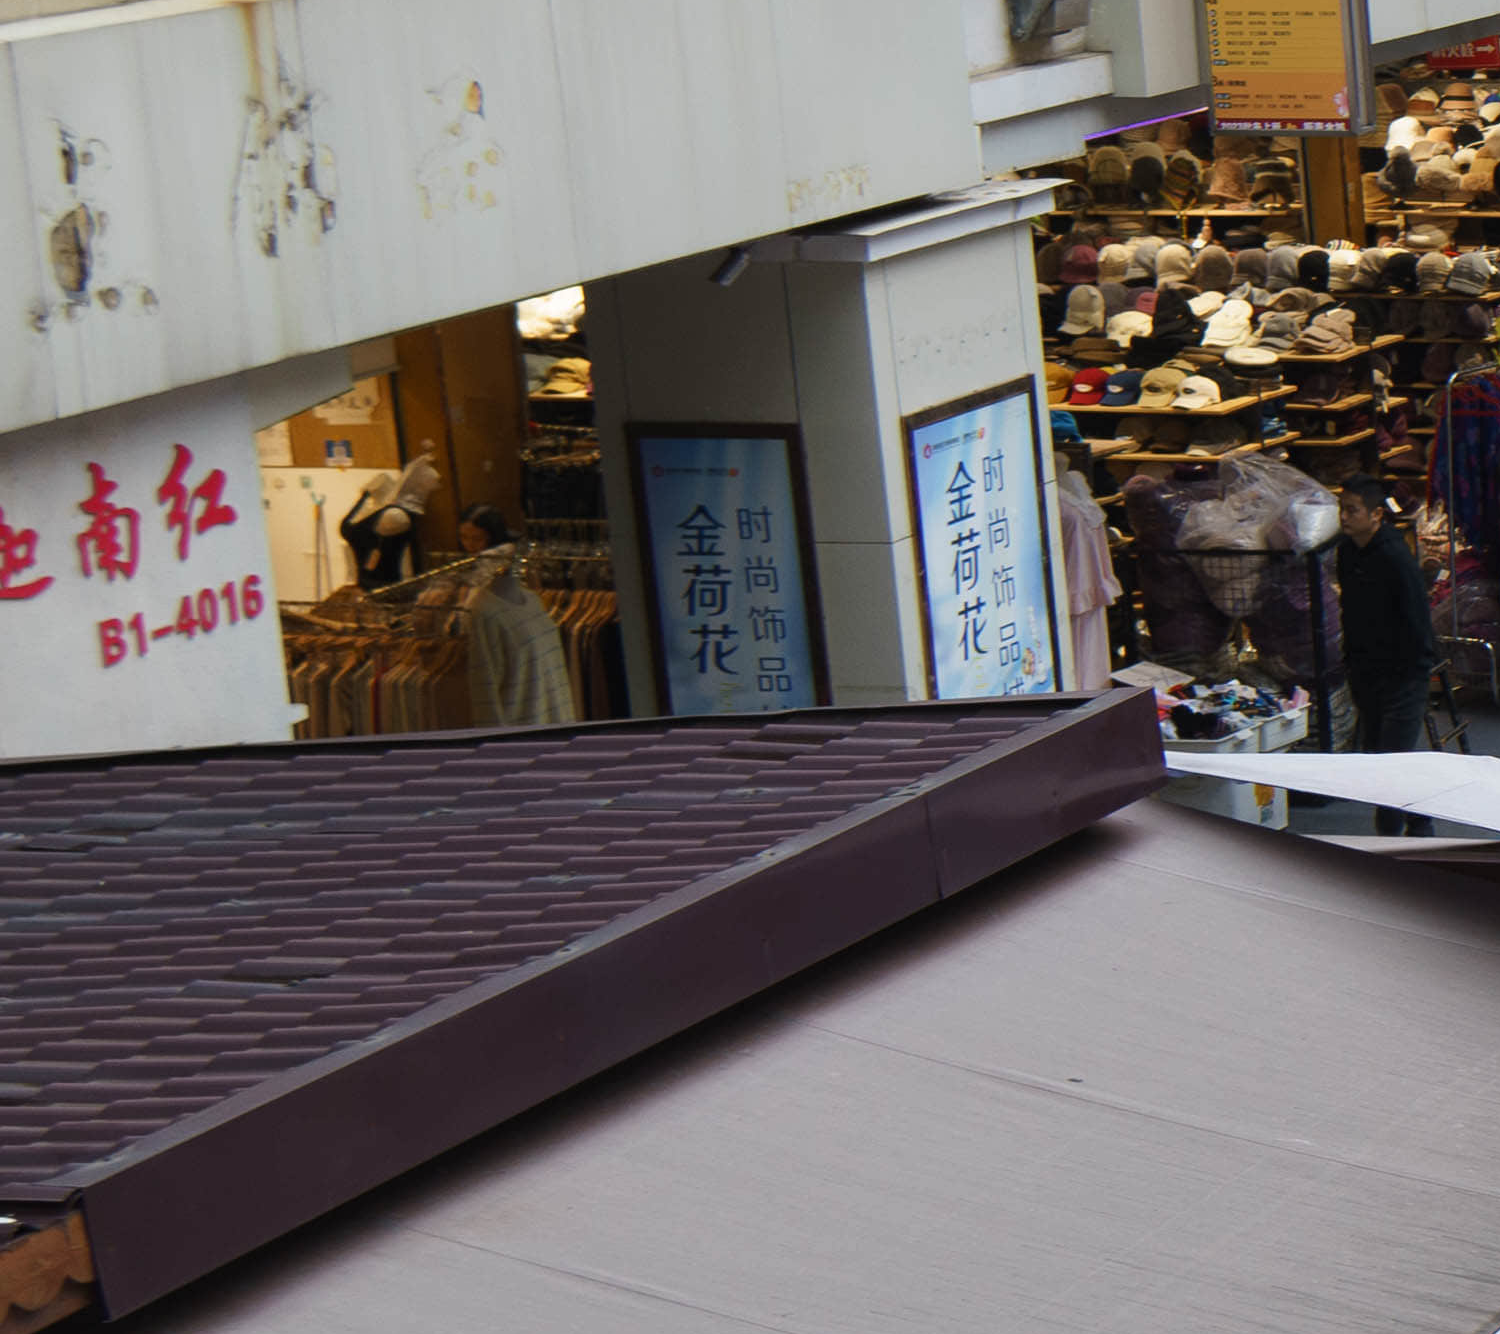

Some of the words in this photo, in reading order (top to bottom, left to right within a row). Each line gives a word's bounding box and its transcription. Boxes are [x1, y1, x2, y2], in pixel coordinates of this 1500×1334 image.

[98, 573, 265, 668] B1-4016
[676, 503, 740, 677] 金荷花
[737, 505, 793, 697] 时尚饰品
[944, 460, 990, 663] 金荷花
